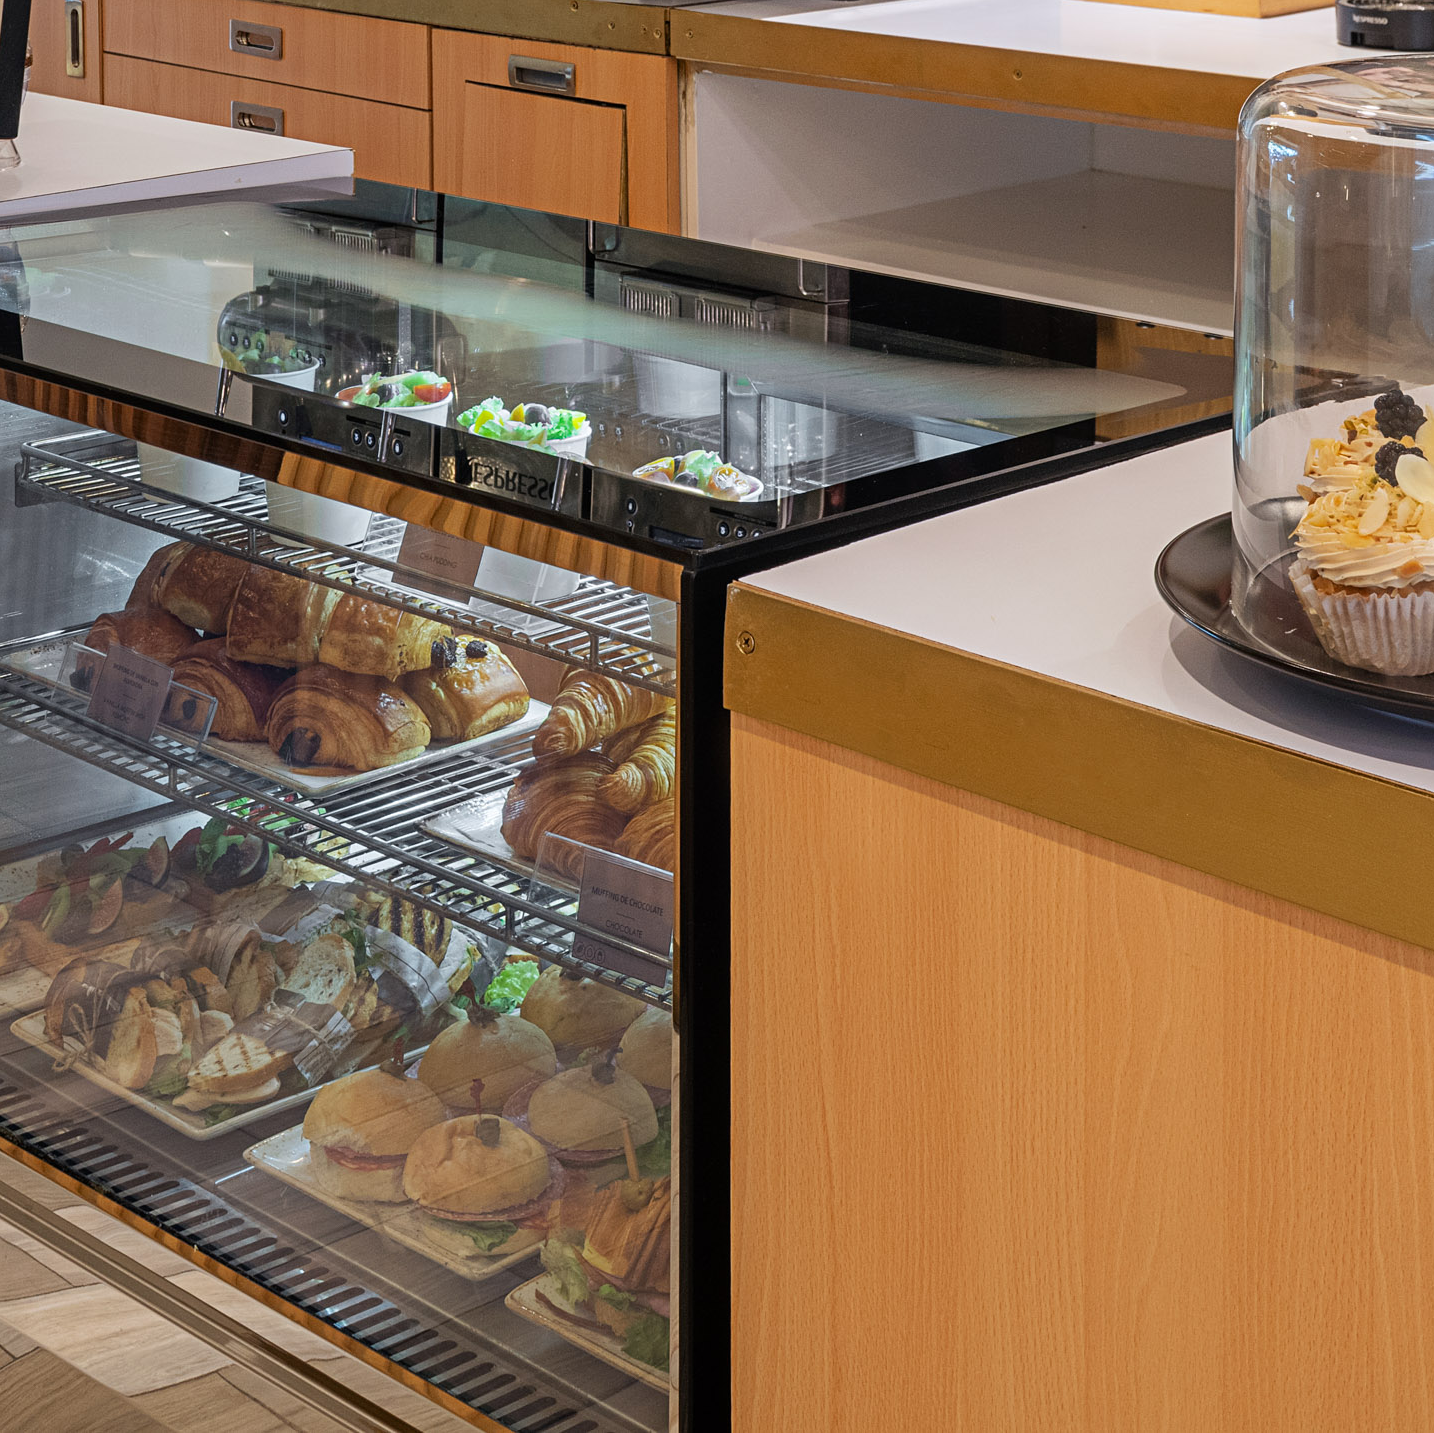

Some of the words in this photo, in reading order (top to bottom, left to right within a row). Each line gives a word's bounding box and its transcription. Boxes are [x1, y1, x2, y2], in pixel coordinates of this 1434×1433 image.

[620, 894, 629, 905] DE
[629, 898, 664, 917] CHOCOLATE
[605, 919, 643, 939] CHOCOLATE
